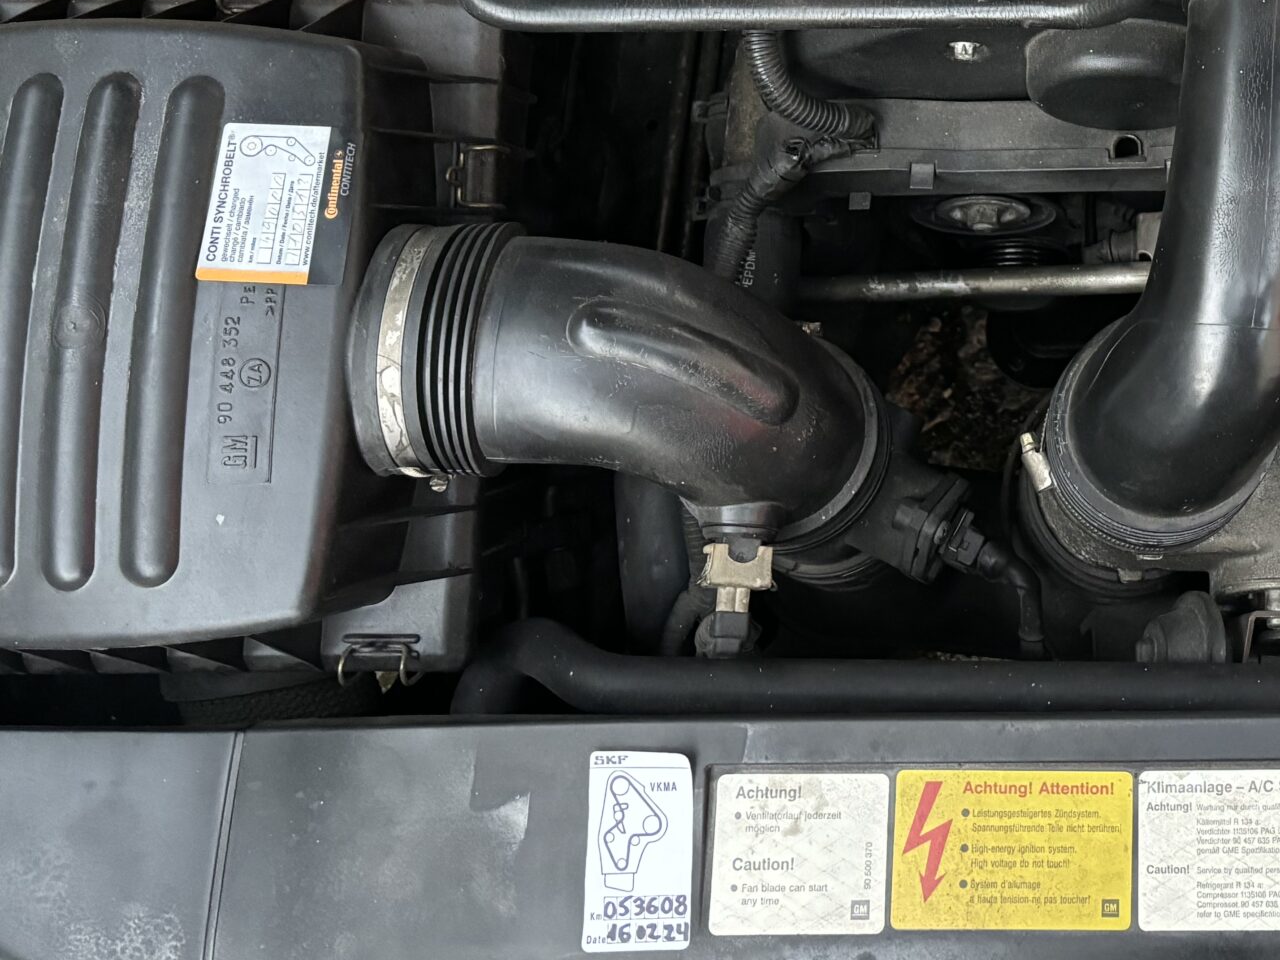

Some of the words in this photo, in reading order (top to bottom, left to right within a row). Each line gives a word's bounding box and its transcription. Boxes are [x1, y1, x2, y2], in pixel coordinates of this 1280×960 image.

[341, 142, 356, 195] CONTITECH
[324, 159, 343, 219] Continental
[234, 197, 246, 231] cambiado
[303, 152, 325, 266] www.contitech.de/aftermarket
[220, 223, 232, 262] gewechselt
[228, 188, 240, 217] changed
[206, 226, 222, 262] CONTI
[237, 231, 249, 263] cambiata
[222, 316, 240, 348] 352
[219, 357, 235, 393] 448
[217, 402, 233, 424] 90
[221, 435, 248, 469] GM
[594, 755, 629, 766] SKF
[650, 782, 677, 792] VKMA
[963, 781, 1033, 798] Achtung!
[1039, 781, 1115, 795] Attention!
[1147, 781, 1232, 795] Klimaanlage
[1248, 780, 1274, 793] A/C
[736, 786, 802, 802] Achtung!
[1146, 802, 1192, 813] Achtung!
[1197, 804, 1224, 812] Wartung
[1227, 804, 1238, 812] nur
[804, 811, 842, 821] jederzeit
[972, 809, 1052, 820] Leistungsgesteigertes
[1234, 818, 1239, 826] R
[745, 824, 781, 834] möglich
[972, 823, 1045, 834] Spannungsführende
[1066, 823, 1085, 833] nicht
[1197, 827, 1230, 835] Verdichter
[1261, 827, 1275, 835] PAG
[1197, 837, 1230, 845] Verdichter
[865, 842, 873, 856] 370
[971, 844, 1016, 855] High-energy
[1018, 844, 1046, 855] ignition
[1048, 845, 1077, 855] system.
[1222, 847, 1239, 855] GME
[732, 857, 795, 871] Caution!
[970, 859, 988, 869] High
[990, 859, 1017, 870] voltage
[1019, 859, 1029, 868] do
[1032, 859, 1044, 868] not
[1047, 859, 1070, 868] touch!
[1146, 865, 1190, 875] Caution!
[1197, 867, 1222, 875] Service
[1224, 867, 1232, 875] by
[1235, 867, 1263, 875] qualified
[741, 883, 758, 893] Fan
[761, 883, 786, 893] blade
[788, 885, 805, 893] can
[808, 883, 828, 893] start
[864, 876, 872, 890] 90
[970, 880, 998, 890] System
[1197, 881, 1234, 890] Refrigerant
[1236, 881, 1242, 890] R
[977, 895, 997, 905] haute
[1044, 896, 1058, 905] pas
[1060, 895, 1091, 905] toucher!
[1197, 891, 1238, 899] Compressor
[741, 898, 758, 907] any
[761, 896, 780, 906] time
[604, 896, 688, 919] 053608
[853, 904, 869, 917] GM
[1197, 910, 1212, 918] refer
[1214, 910, 1221, 918] to
[1223, 910, 1240, 918] GME
[586, 936, 606, 945] Date
